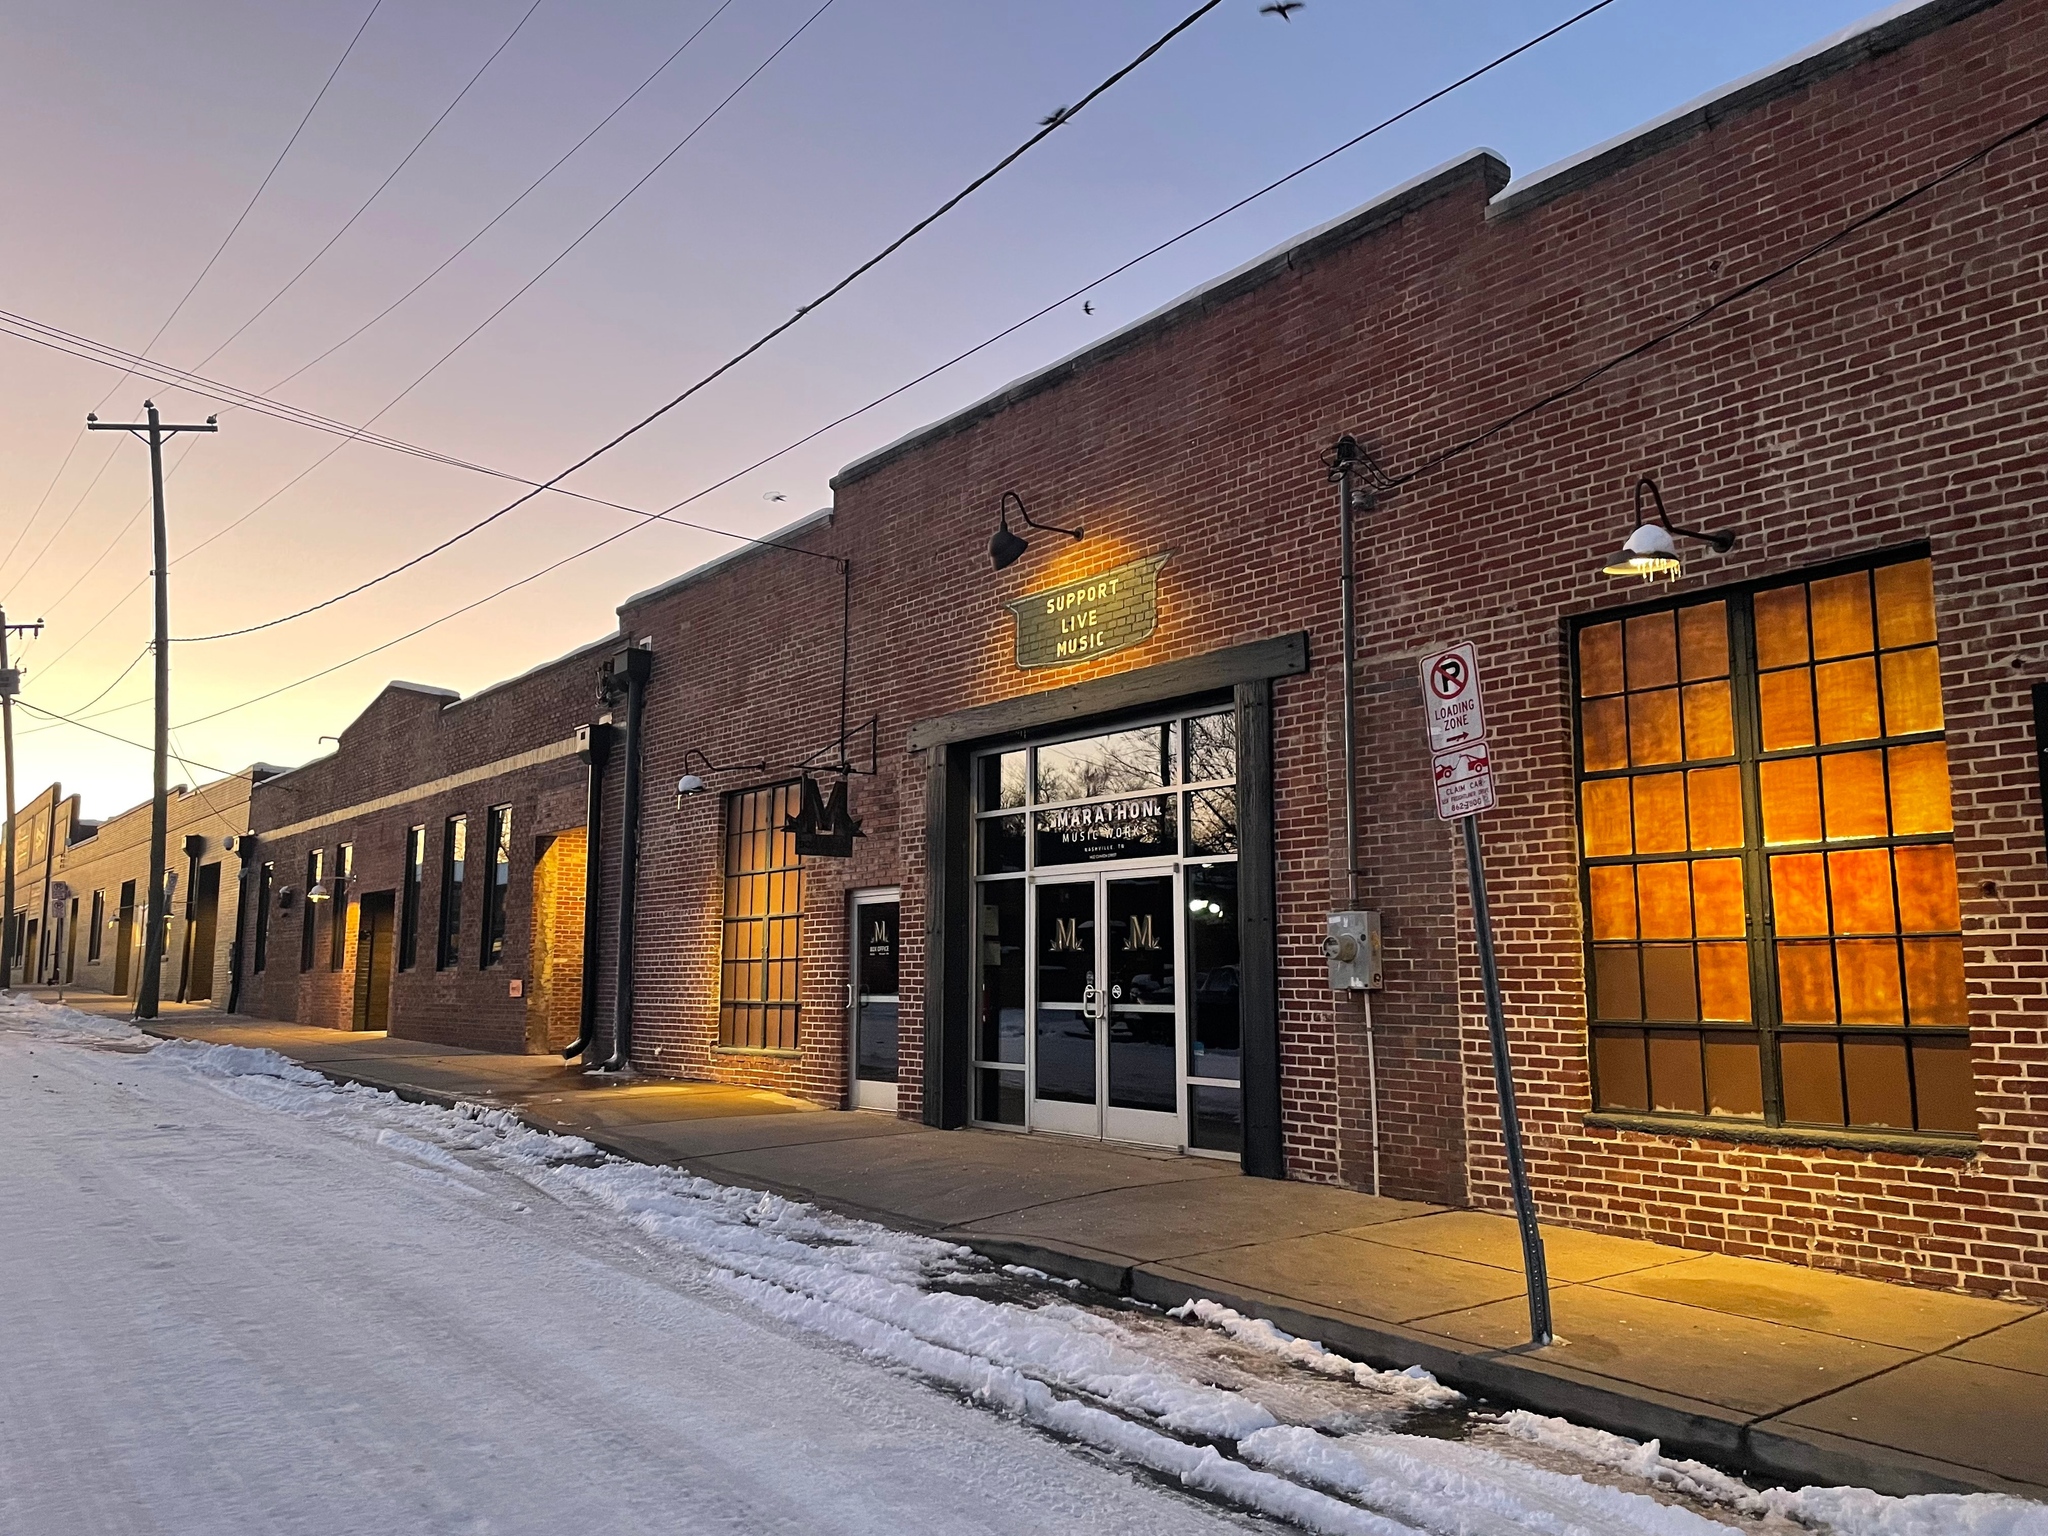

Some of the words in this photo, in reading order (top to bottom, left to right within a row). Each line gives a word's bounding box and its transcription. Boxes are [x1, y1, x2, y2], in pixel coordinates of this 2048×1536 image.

[1046, 578, 1119, 614] SUPPORT
[1061, 609, 1098, 634] LIVE
[1056, 631, 1104, 658] MUSIC
[1434, 698, 1475, 721] LOADING
[1444, 714, 1470, 732] ZONE
[1445, 784, 1466, 796] CLAIM
[1057, 799, 1153, 828] MARATHON
[1062, 830, 1098, 843] MUSIC
[1105, 824, 1148, 839] WORKS
[1055, 917, 1076, 950] M
[1129, 914, 1153, 950] M
